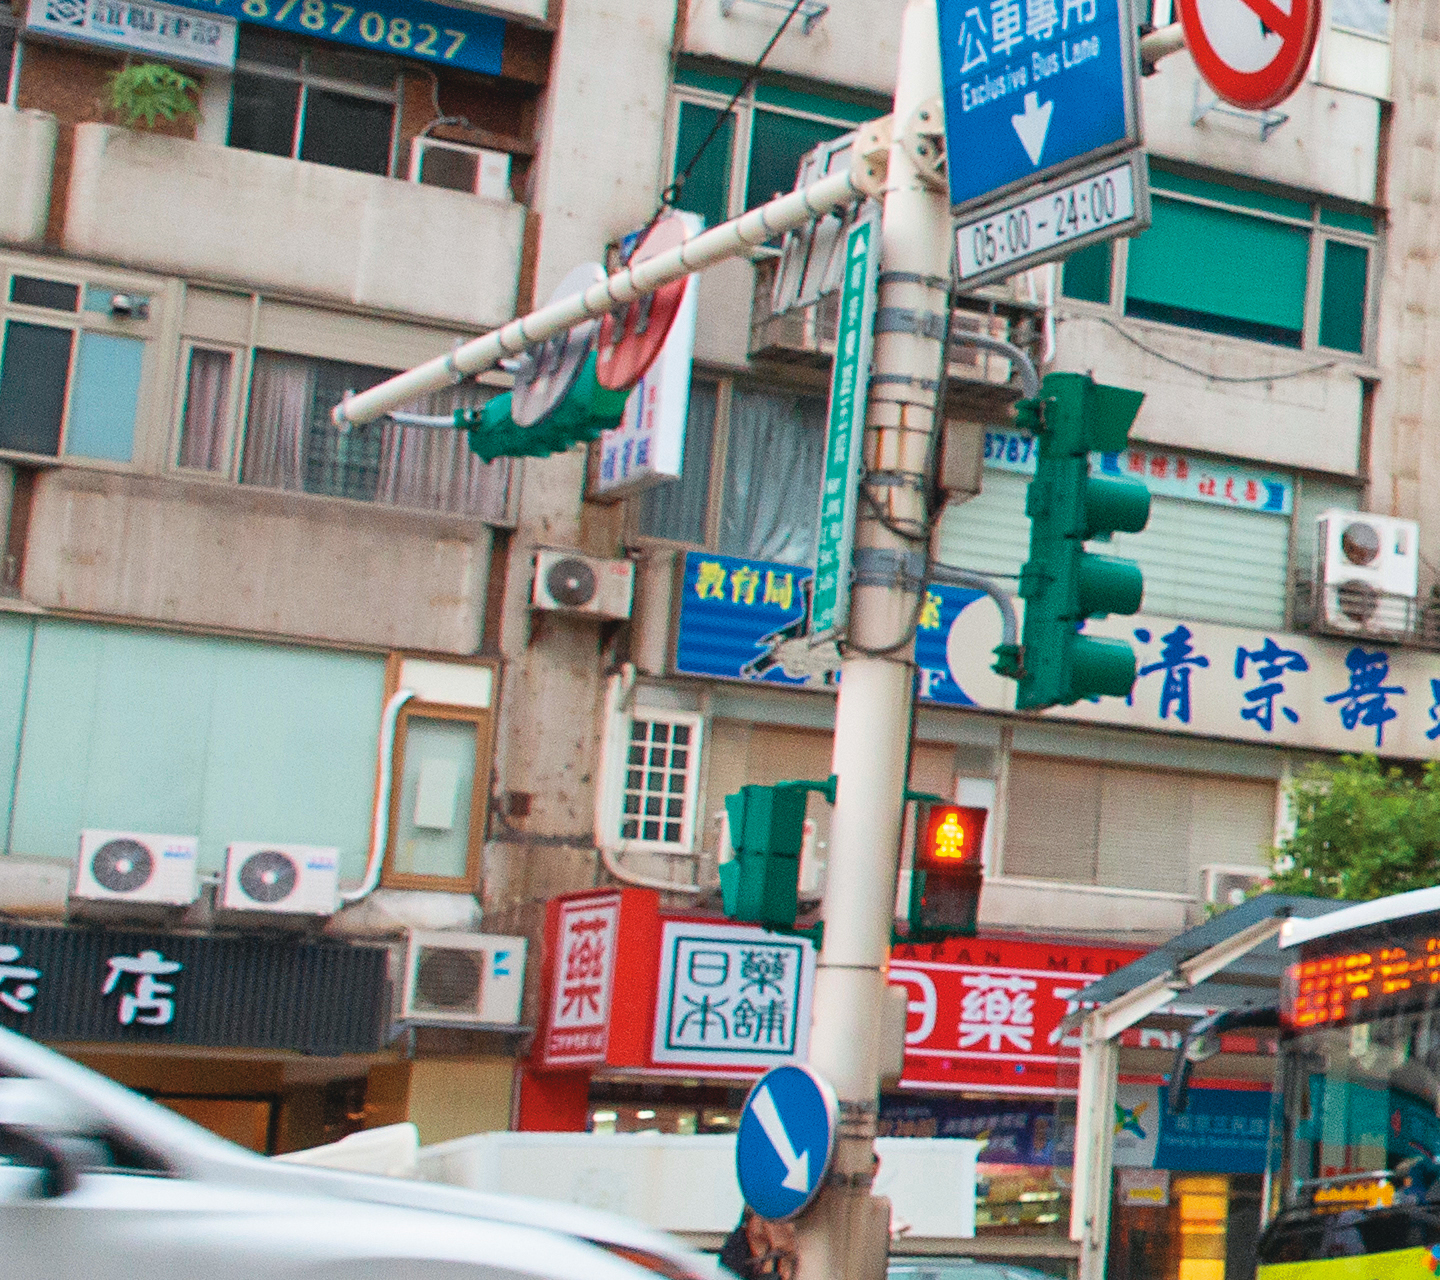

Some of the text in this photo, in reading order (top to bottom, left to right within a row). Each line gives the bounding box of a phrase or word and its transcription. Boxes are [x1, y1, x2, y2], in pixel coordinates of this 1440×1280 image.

[961, 33, 1100, 112] Exclusive Bus Lane
[972, 215, 1032, 269] 05:00
[1054, 177, 1119, 234] 24:00
[903, 943, 1001, 964] APAN
